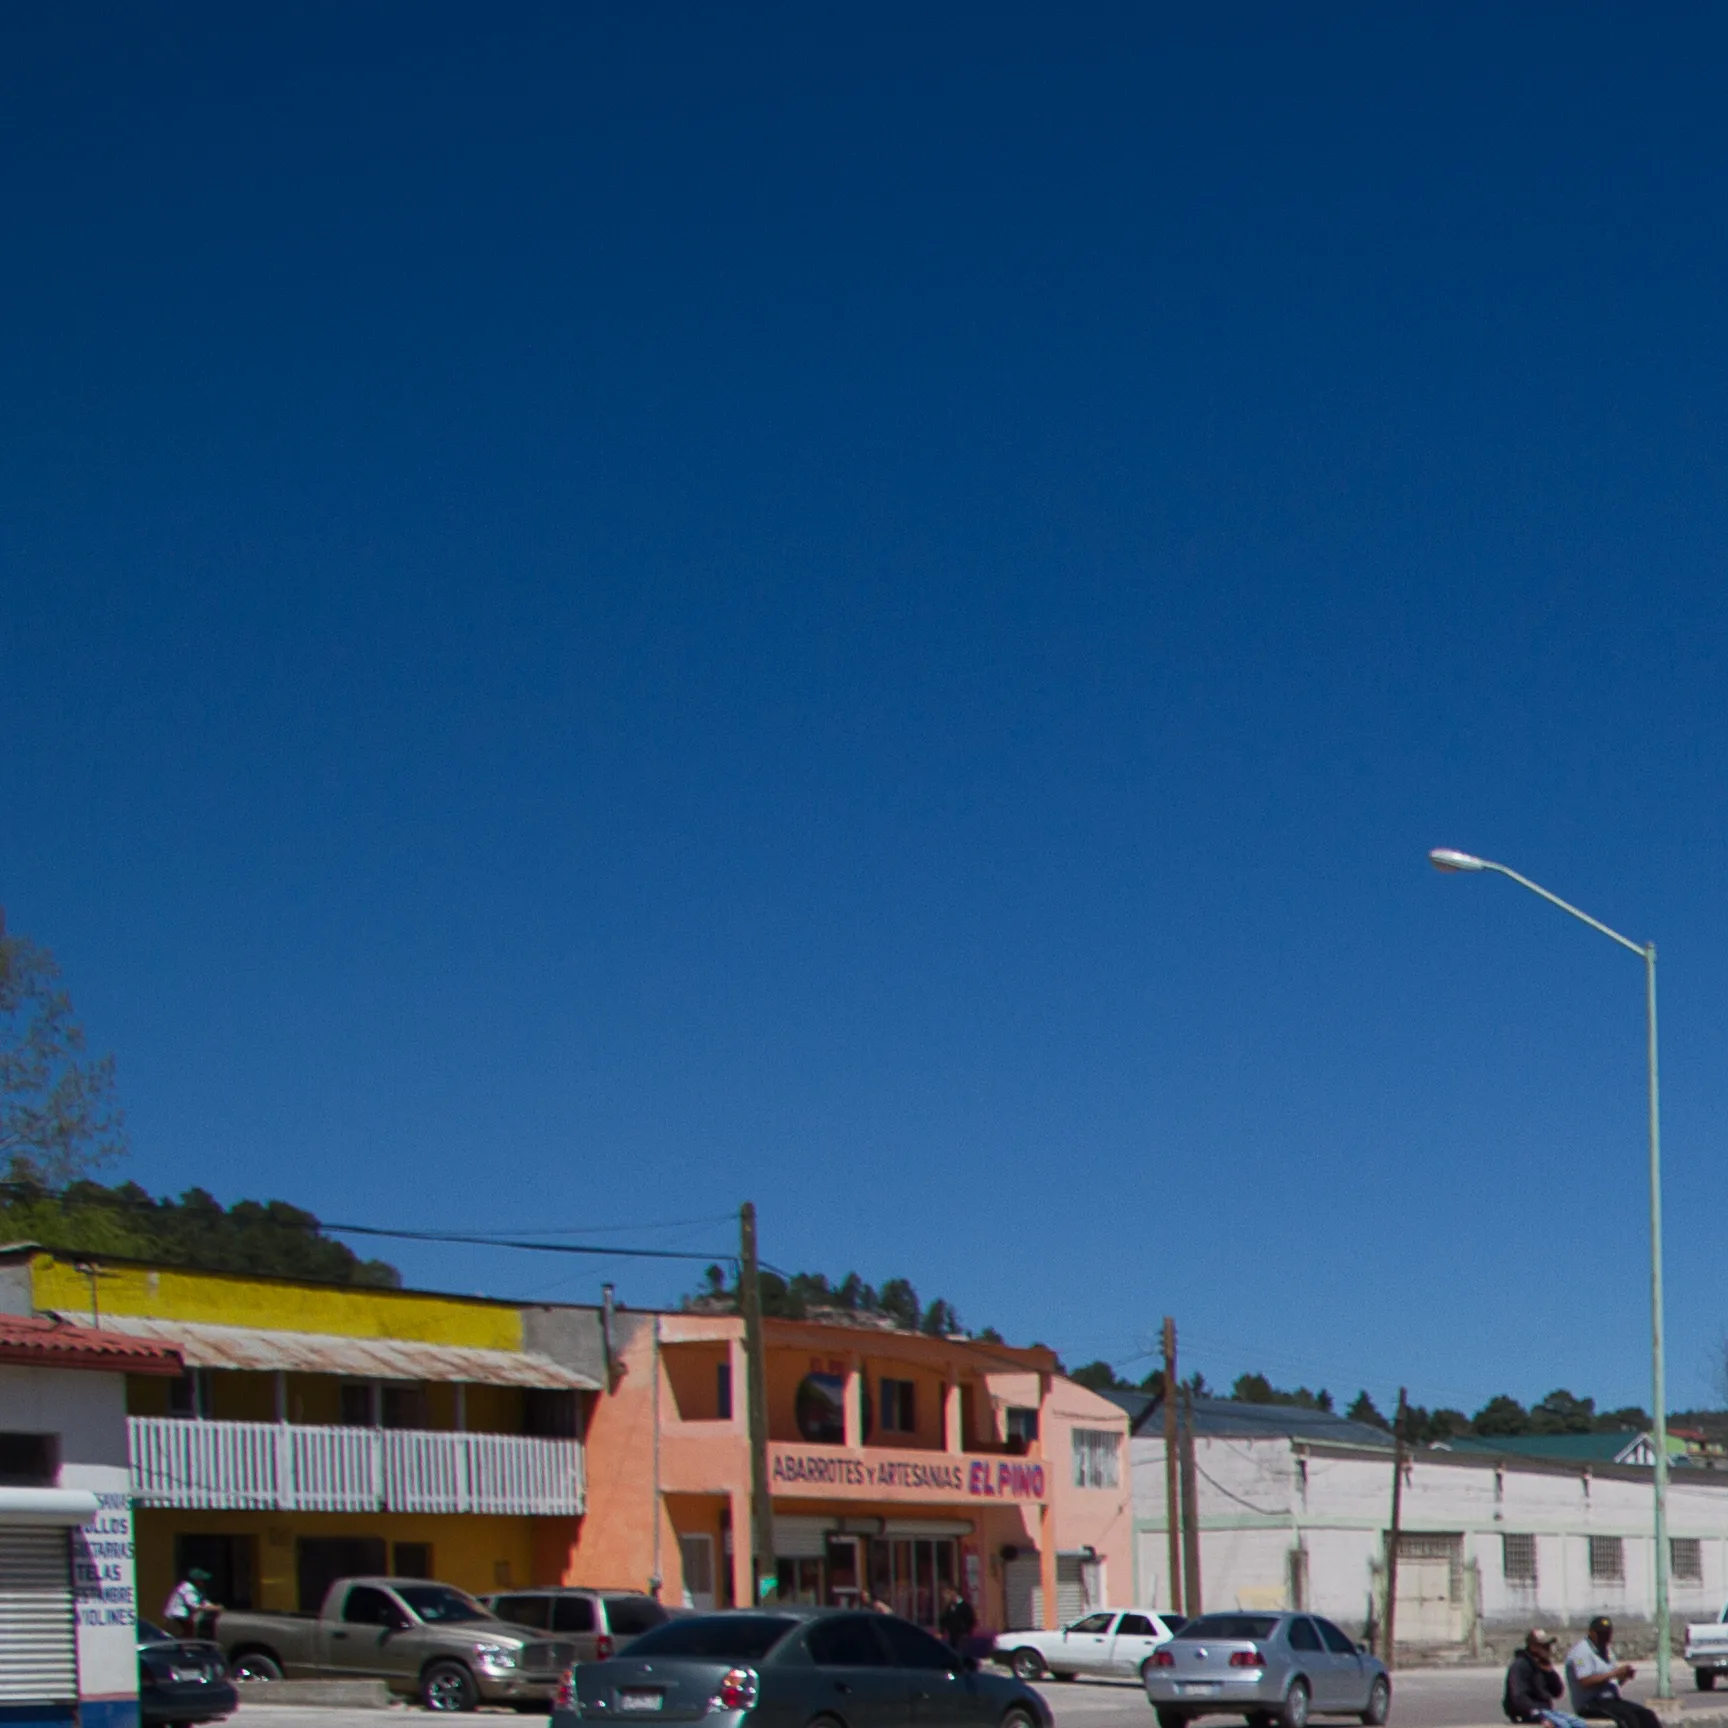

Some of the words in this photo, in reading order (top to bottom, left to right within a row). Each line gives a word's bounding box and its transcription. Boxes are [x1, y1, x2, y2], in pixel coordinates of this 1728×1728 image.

[774, 1455, 864, 1485] ABARROTES
[877, 1462, 963, 1490] ARTESANIAS
[968, 1460, 995, 1497] EL
[997, 1462, 1046, 1499] PINO
[76, 1563, 122, 1581] TELAS
